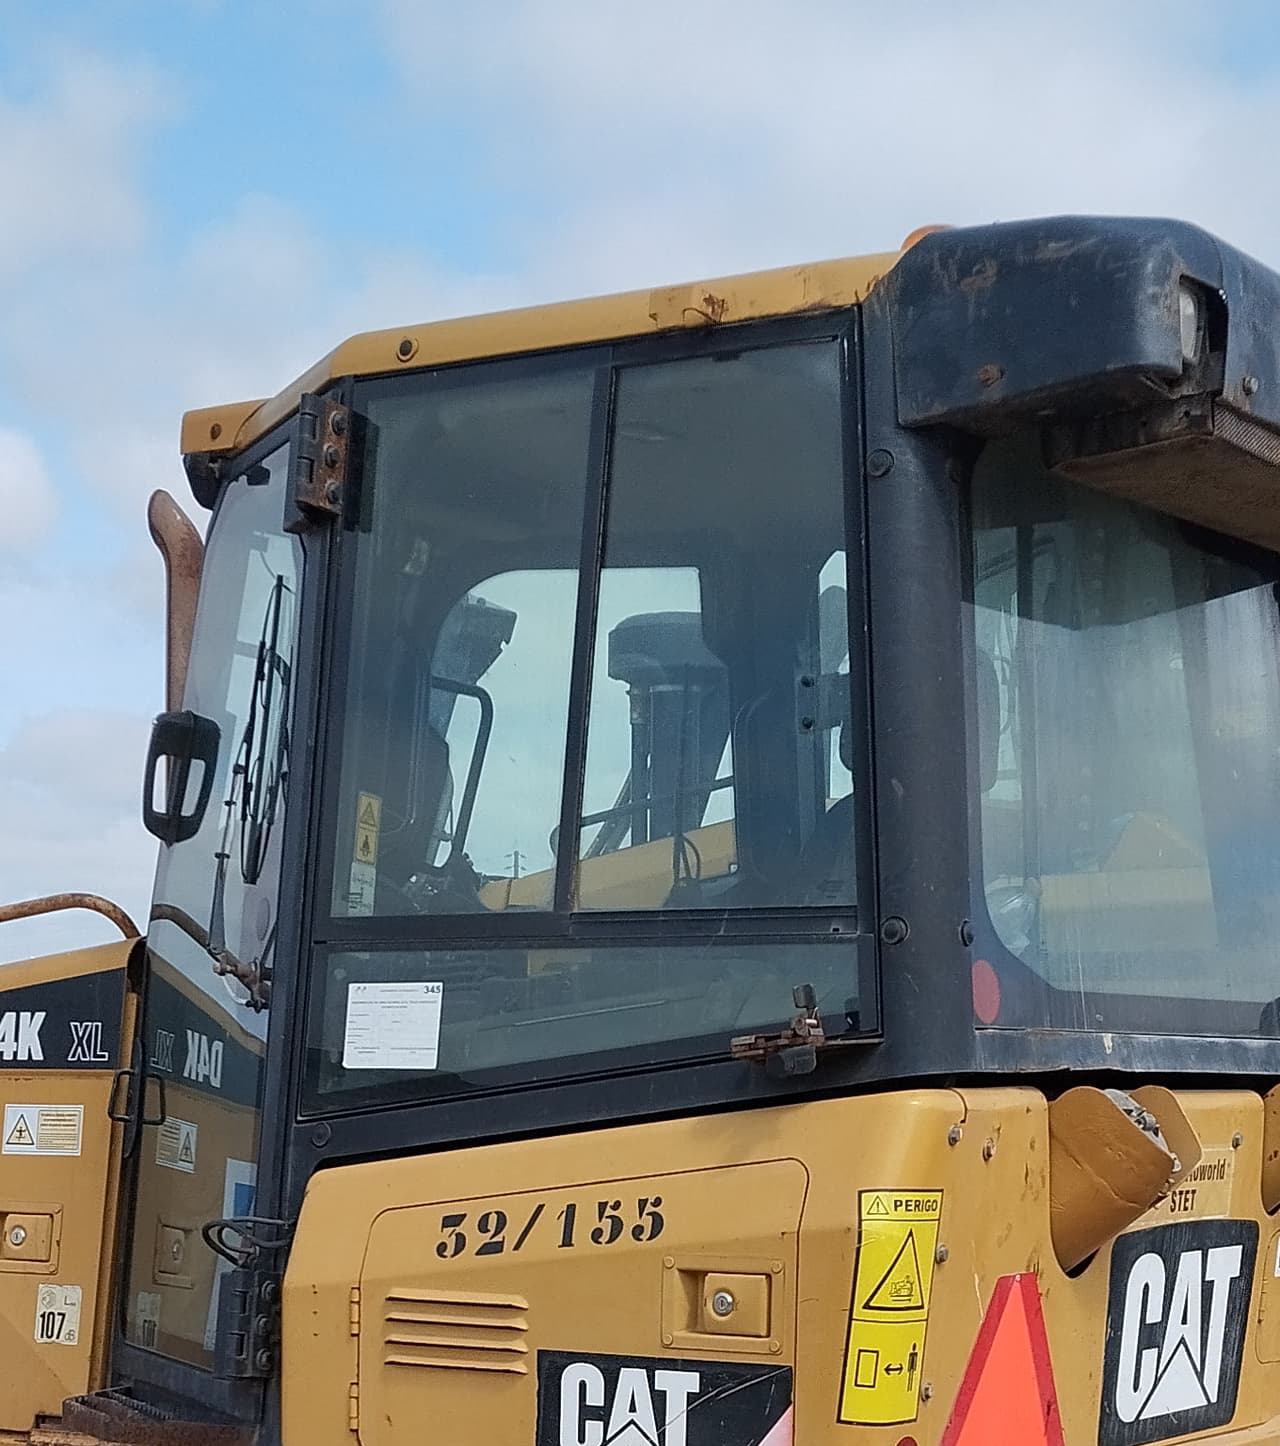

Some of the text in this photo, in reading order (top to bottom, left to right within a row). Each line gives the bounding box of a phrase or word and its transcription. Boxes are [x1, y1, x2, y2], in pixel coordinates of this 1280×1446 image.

[423, 985, 441, 994] 345
[67, 1022, 109, 1062] XL
[893, 1199, 938, 1213] PERIGO
[1169, 1189, 1197, 1213] STET
[436, 1196, 665, 1258] 32/155
[39, 1311, 66, 1340] 107
[1115, 1243, 1245, 1424] CAT
